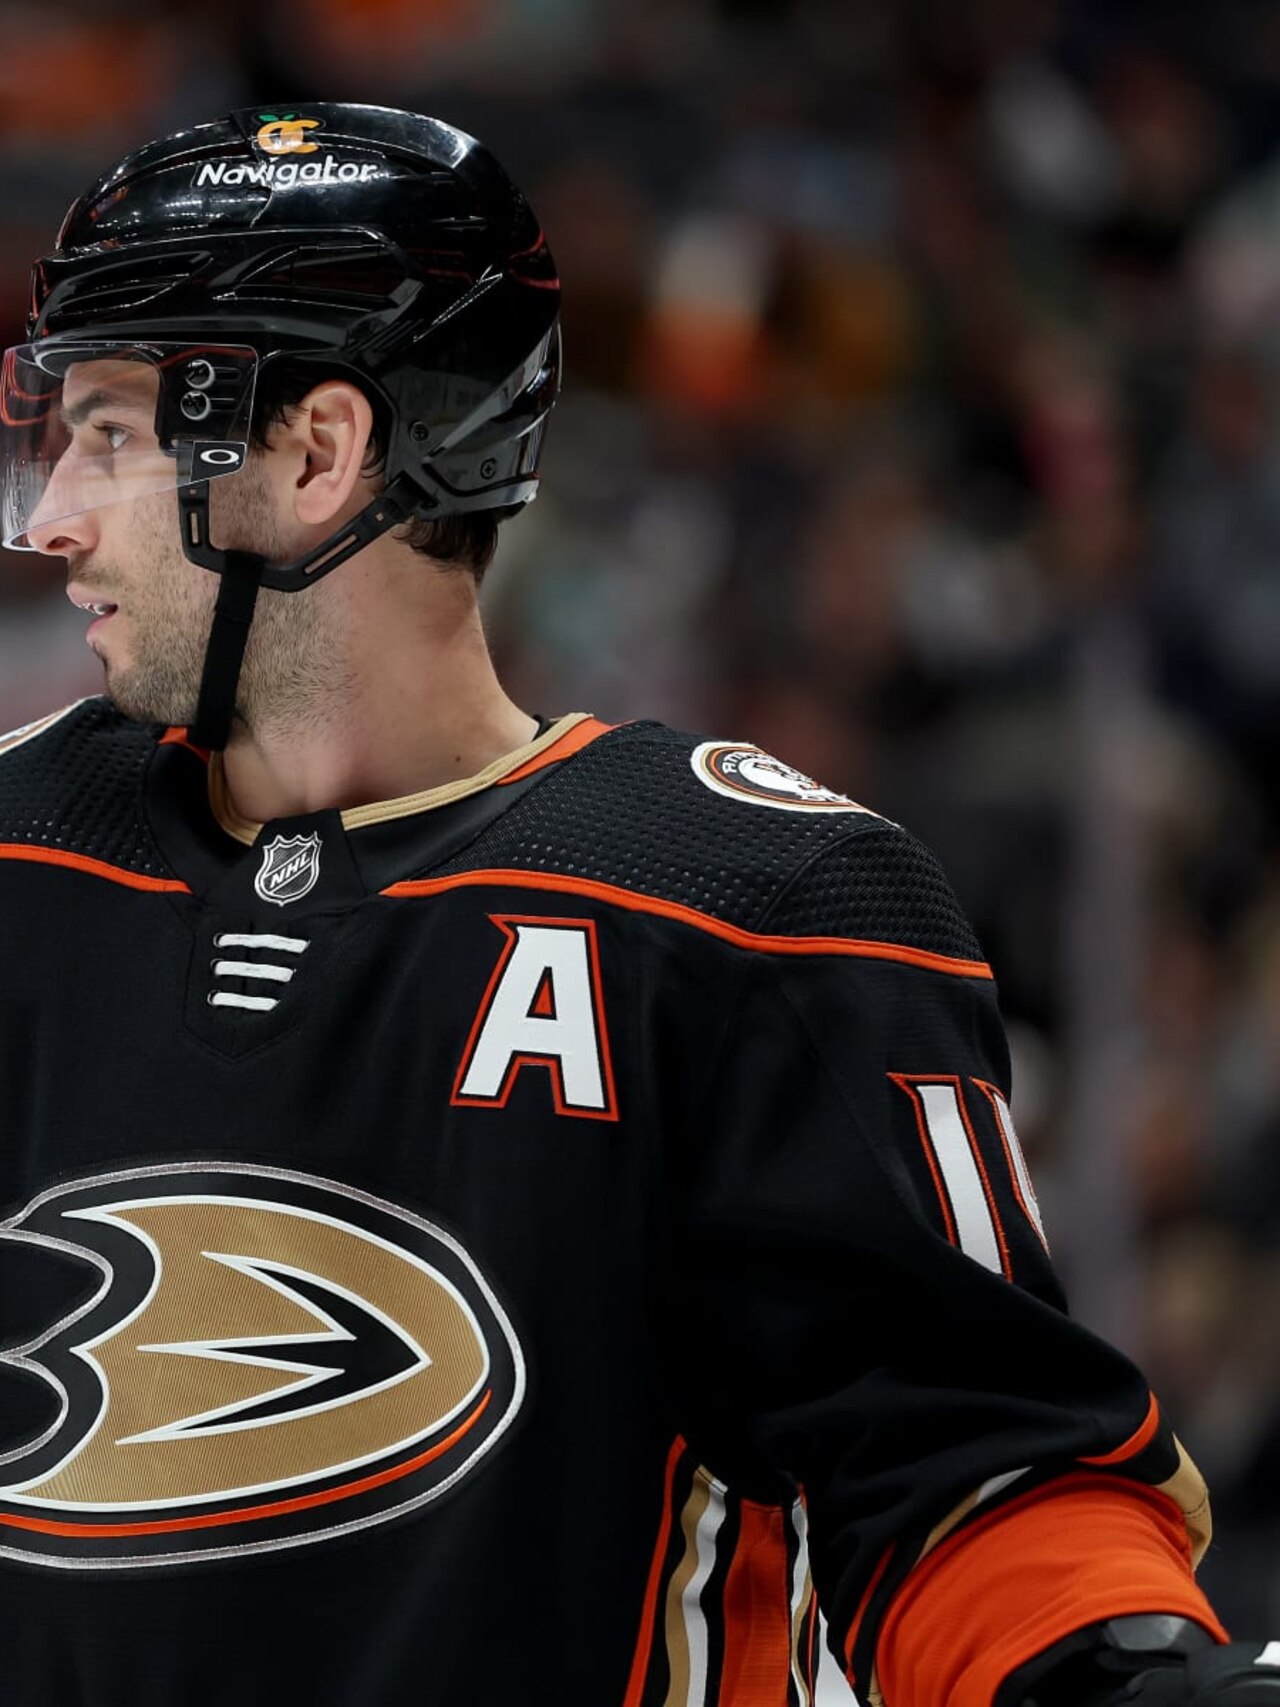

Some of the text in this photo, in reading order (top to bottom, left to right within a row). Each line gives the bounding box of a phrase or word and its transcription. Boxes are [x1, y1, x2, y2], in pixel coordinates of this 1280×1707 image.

[197, 155, 378, 191] Navigator
[269, 852, 311, 889] NHL
[450, 914, 620, 1122] A
